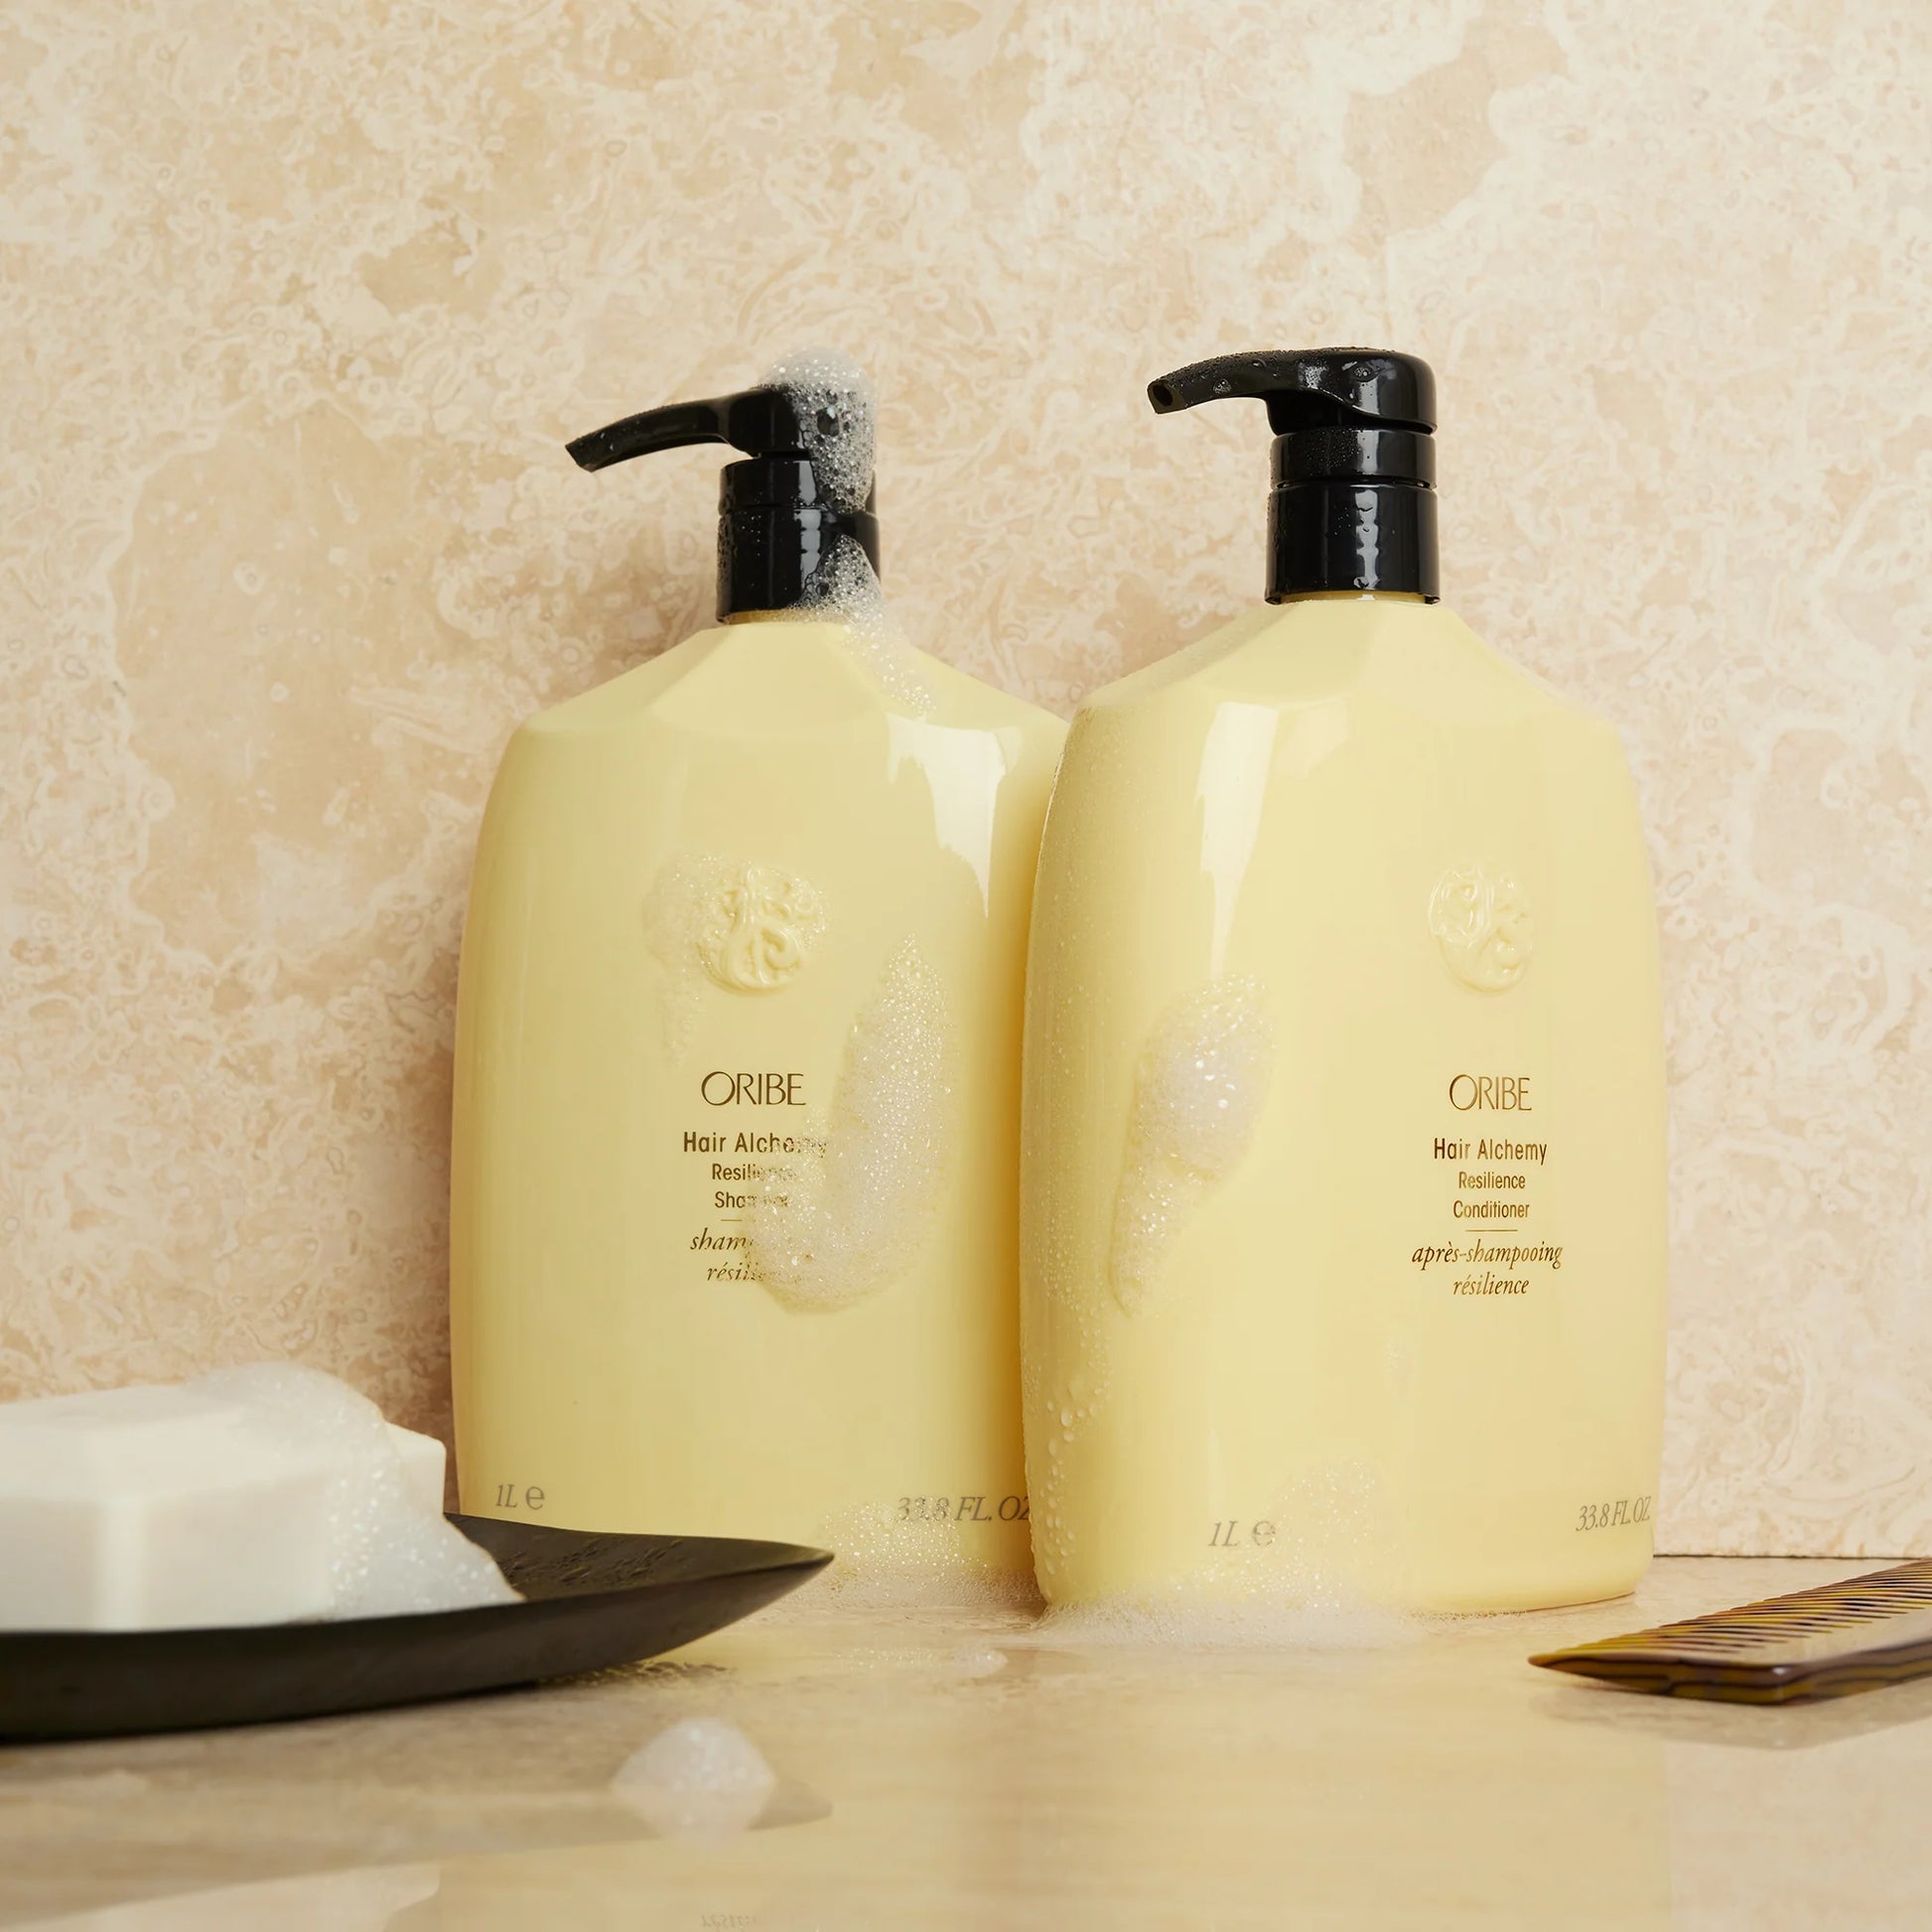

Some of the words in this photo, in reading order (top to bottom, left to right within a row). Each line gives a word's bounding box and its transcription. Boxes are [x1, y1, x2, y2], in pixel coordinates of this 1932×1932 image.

[701, 1070, 807, 1106] ORIBE
[1449, 1073, 1533, 1111] ORIBE
[683, 1131, 727, 1153] Hair
[1434, 1137, 1471, 1160] Hair
[1476, 1138, 1548, 1166] Alchemy
[1458, 1171, 1526, 1189] Resilience
[1452, 1199, 1530, 1219] Conditioner
[1411, 1238, 1564, 1271] après-shampooing
[1452, 1271, 1530, 1296] résilience
[495, 1483, 518, 1508] 1L
[953, 1495, 993, 1522] FL.
[1575, 1502, 1610, 1532] 33.8
[1632, 1495, 1652, 1524] OZ
[1207, 1519, 1241, 1547] 1L
